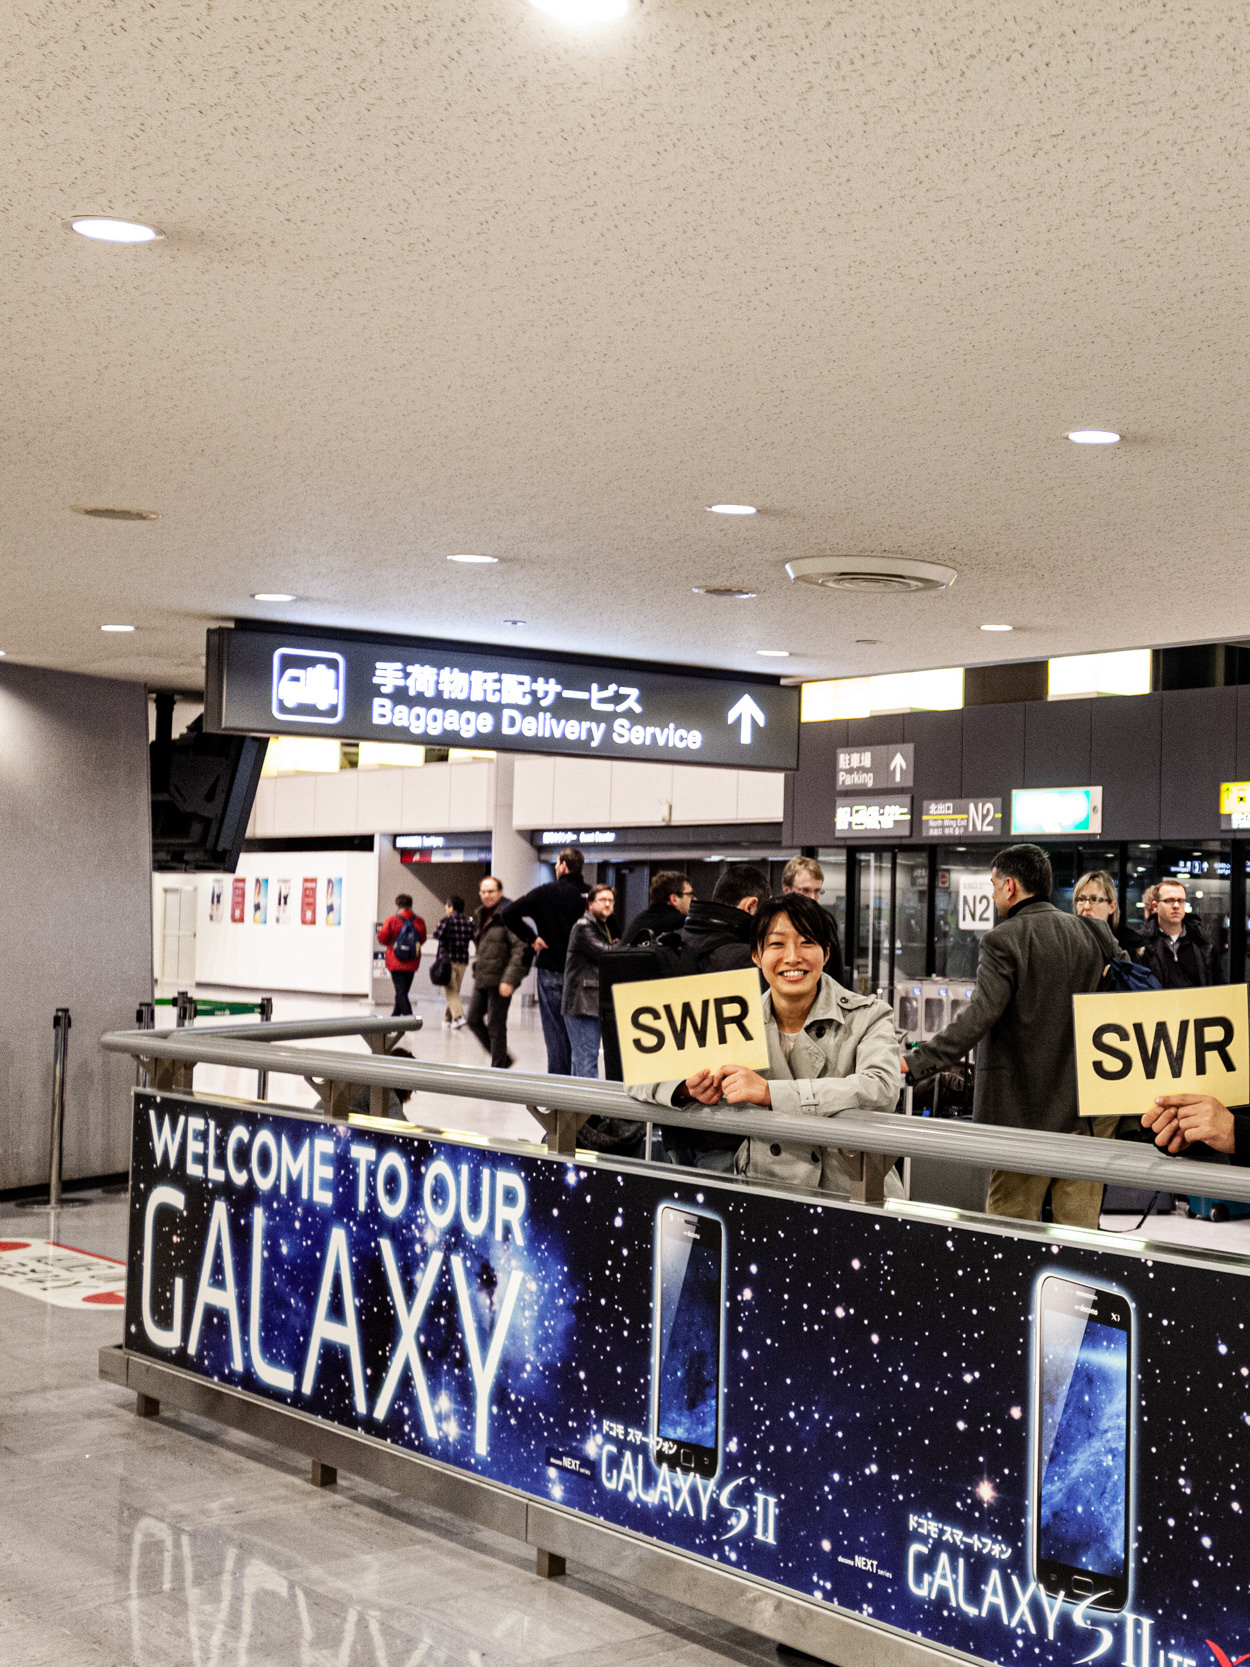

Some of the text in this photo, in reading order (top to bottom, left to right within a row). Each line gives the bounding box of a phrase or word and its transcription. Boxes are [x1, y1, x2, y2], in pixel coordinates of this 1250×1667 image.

[372, 697, 702, 750] Baggage Delivery Service
[839, 752, 872, 769] 駐車場
[838, 771, 873, 788] Parking
[929, 802, 953, 815] 北出口
[944, 818, 957, 828] Wing
[968, 802, 994, 832] N2
[962, 894, 991, 922] N2
[631, 995, 754, 1054] SWR
[1092, 1016, 1236, 1081] SWR
[149, 1110, 526, 1247] WELCOME TO OUR
[142, 1186, 524, 1457] GALAXY
[602, 1419, 678, 1456] ドコモ スマートフォン
[562, 1456, 580, 1471] NEXT
[601, 1444, 715, 1521] GALAXY
[719, 1475, 750, 1541] S
[908, 1513, 1013, 1560] ドコモ スマートフォン
[854, 1554, 878, 1573] NEXT
[907, 1543, 1066, 1640] GALAXY
[1072, 1590, 1114, 1665] S
